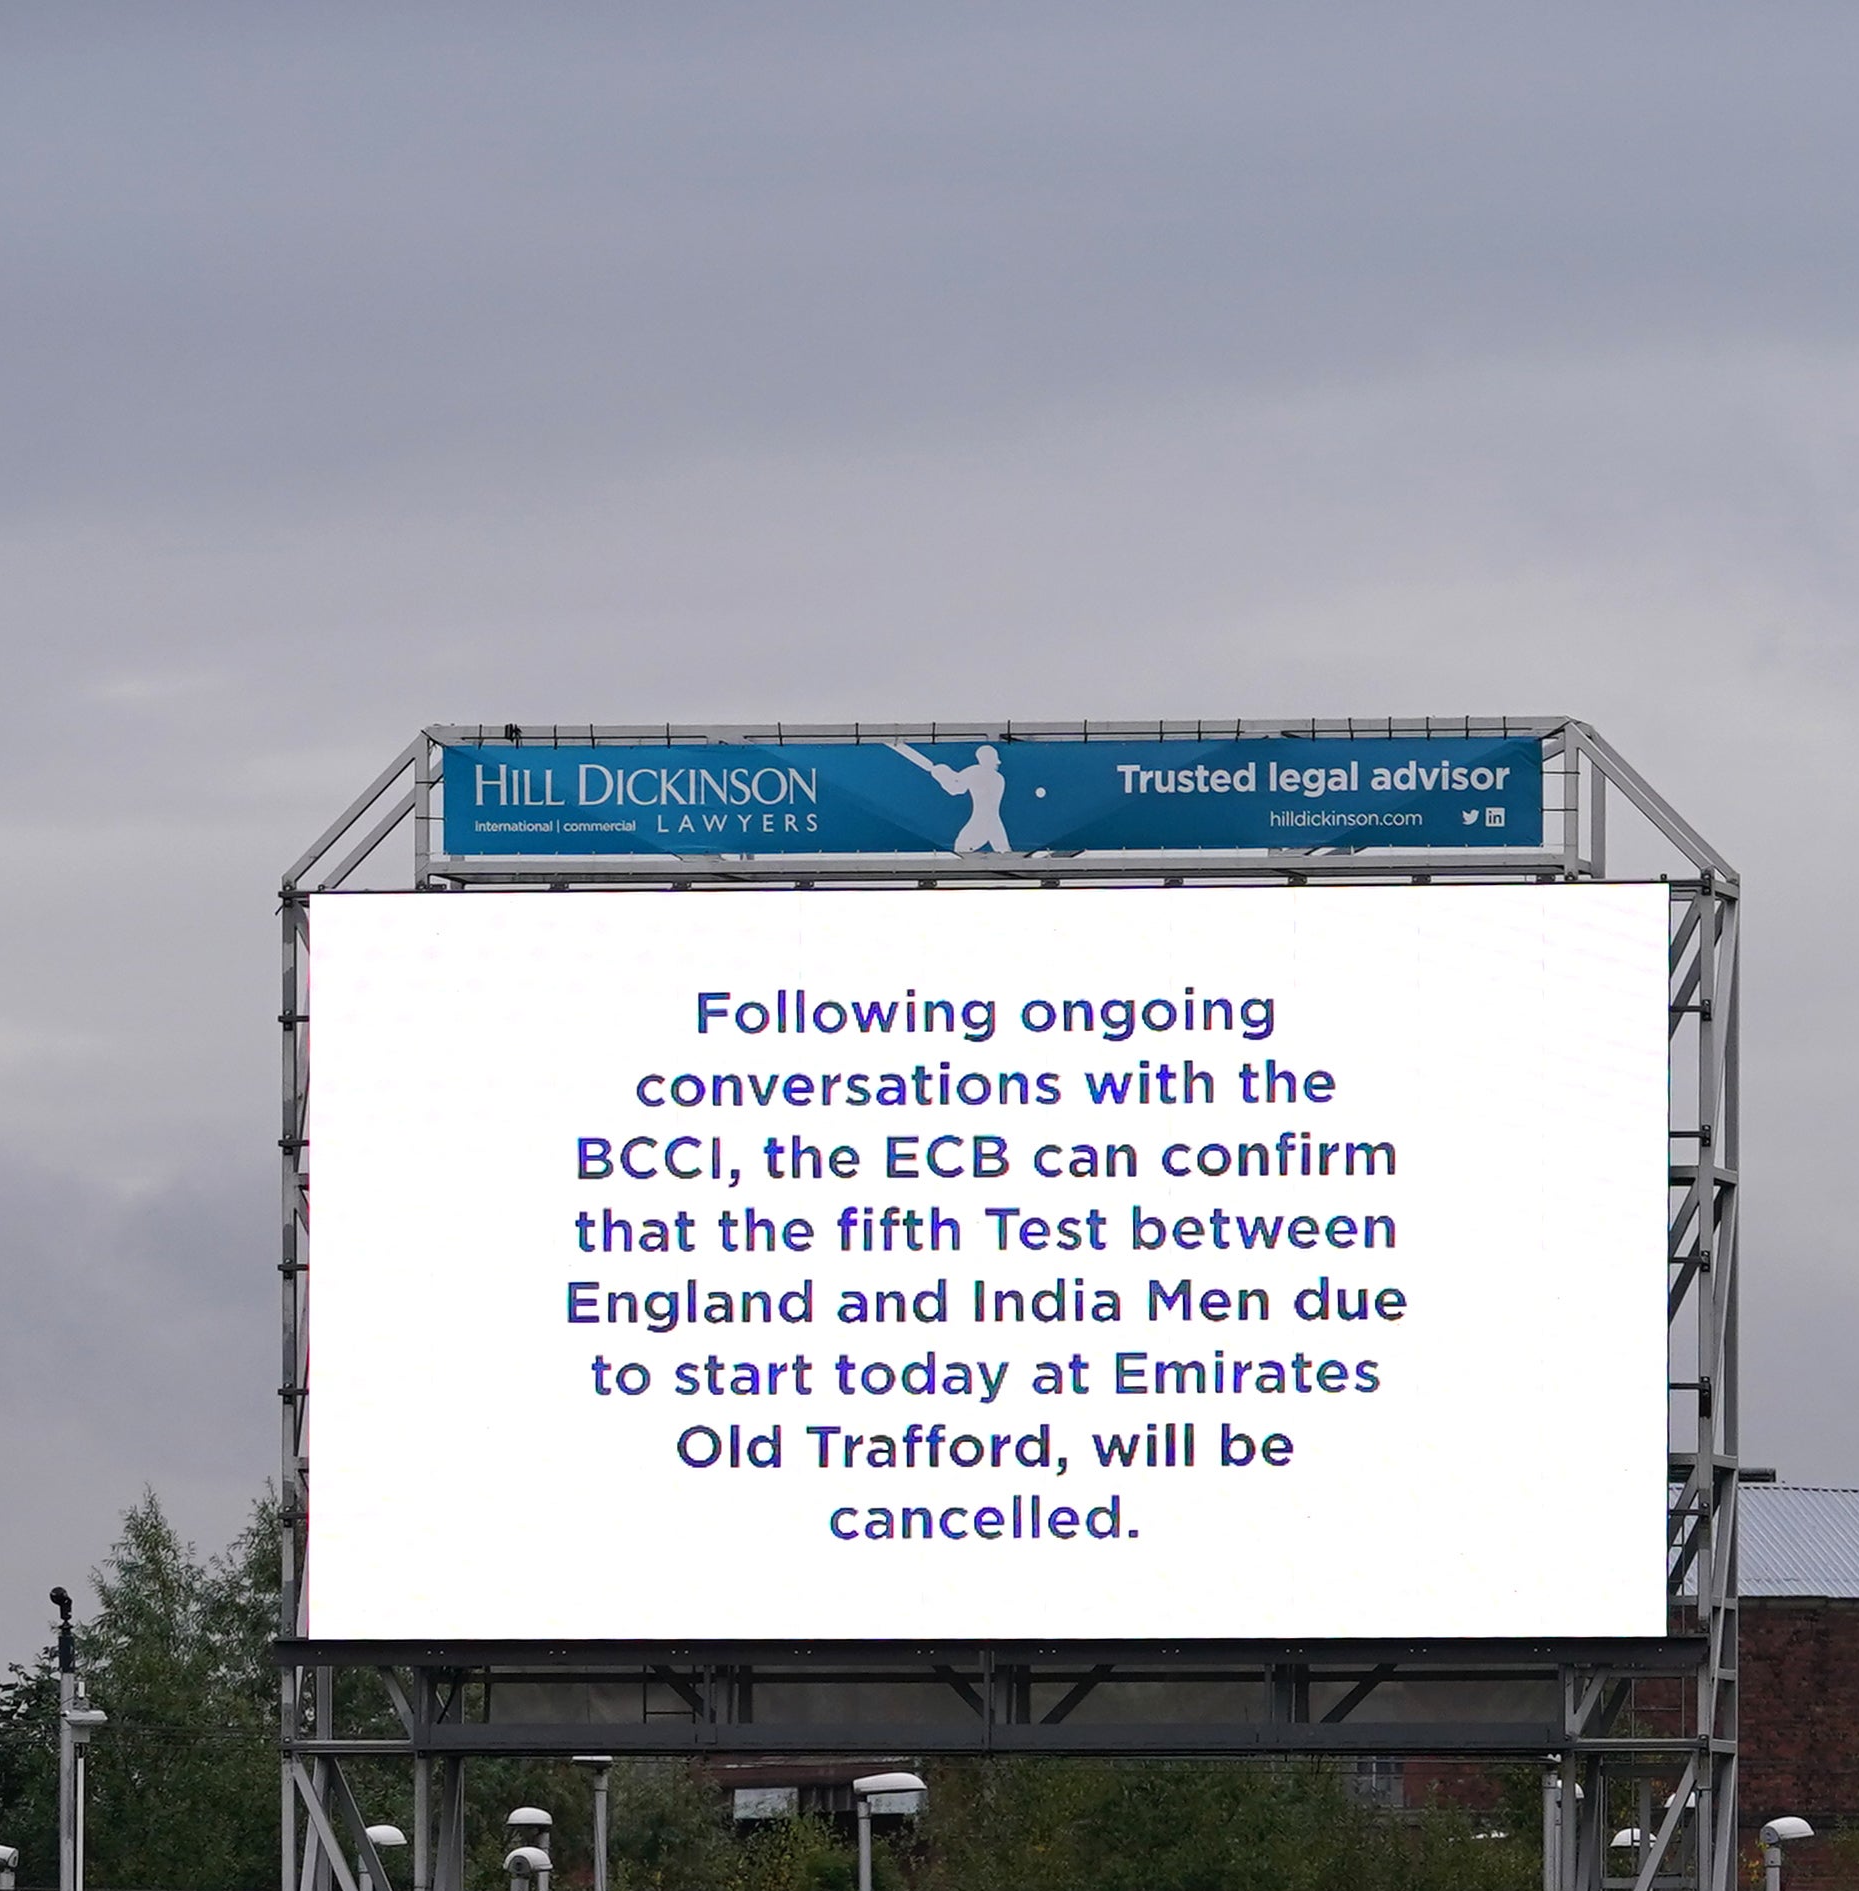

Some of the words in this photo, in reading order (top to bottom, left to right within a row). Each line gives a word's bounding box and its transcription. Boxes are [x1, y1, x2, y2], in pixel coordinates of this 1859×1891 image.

[475, 764, 565, 806] HILL
[579, 763, 818, 806] DICKINSON
[1117, 762, 1257, 794] Trusted
[1269, 761, 1358, 799] legal
[1371, 759, 1510, 792] advisor
[563, 820, 637, 833] commercial
[657, 813, 820, 833] LAWYERS
[1270, 810, 1423, 828] hilldickinson.com
[698, 989, 995, 1042] Following
[1020, 987, 1274, 1041] ongoing
[637, 1062, 1061, 1107] conversations
[1085, 1060, 1213, 1104] with
[1239, 1059, 1335, 1103] the
[577, 1136, 740, 1185] BCCI,
[764, 1135, 859, 1178] the
[887, 1135, 1009, 1178] ECB
[1034, 1144, 1136, 1177] can
[1162, 1132, 1395, 1176] confirm
[575, 1208, 695, 1252] that
[718, 1208, 814, 1252] the
[837, 1206, 960, 1251] fifth
[985, 1208, 1106, 1250] Test
[1132, 1205, 1395, 1250] between
[567, 1279, 812, 1333] England
[837, 1279, 947, 1323] and
[974, 1278, 1120, 1323] India
[1149, 1280, 1269, 1322] Men
[1294, 1276, 1407, 1321] due
[592, 1355, 650, 1395] to
[675, 1355, 812, 1395] start
[835, 1351, 1008, 1403] today
[1032, 1354, 1089, 1394] at
[1116, 1350, 1380, 1394] Emirates
[677, 1425, 781, 1468] Old
[806, 1424, 1067, 1476] Trafford,
[1092, 1423, 1194, 1467] will
[1221, 1423, 1293, 1466] be
[830, 1495, 1138, 1540] cancelled.
